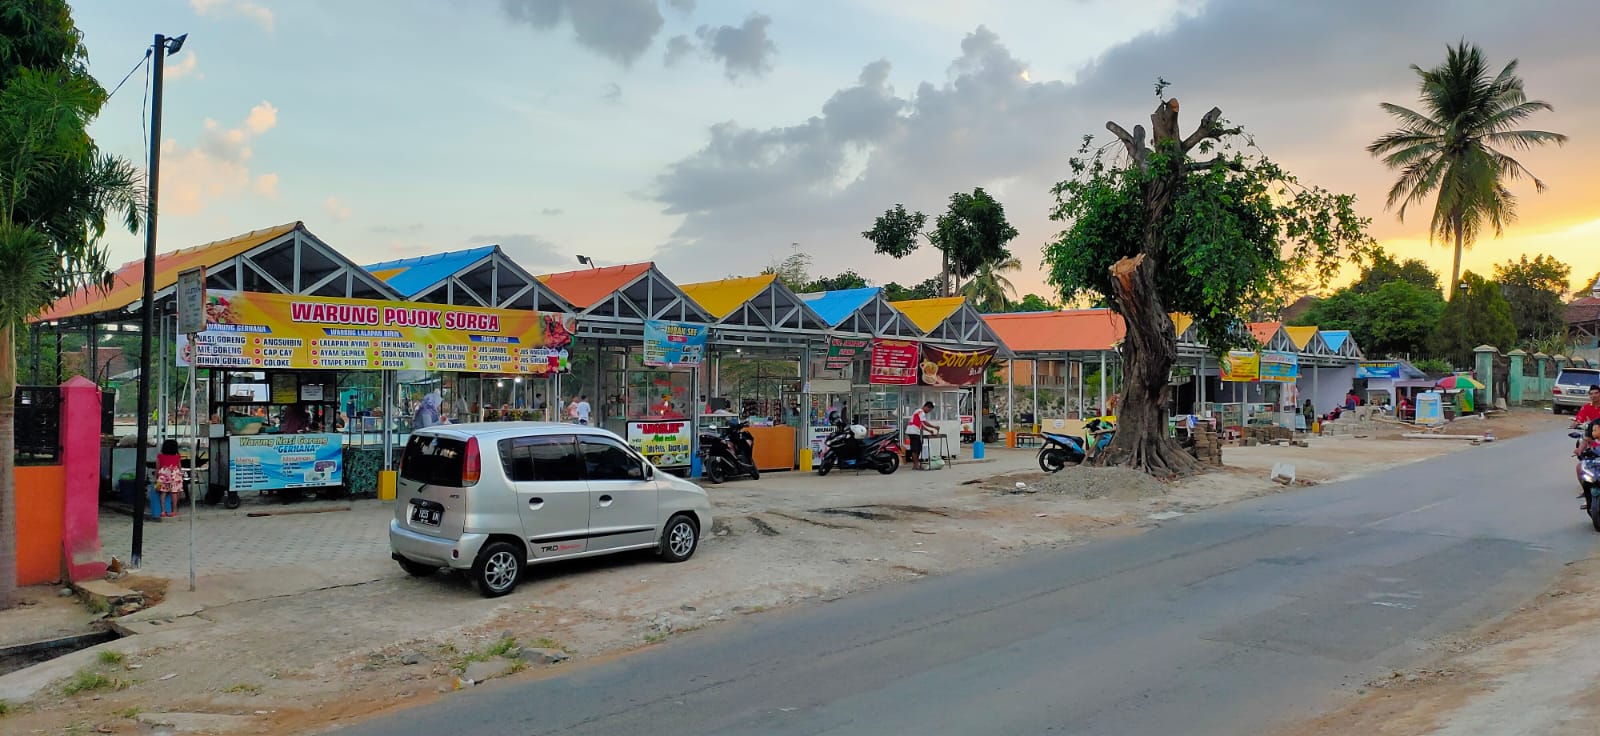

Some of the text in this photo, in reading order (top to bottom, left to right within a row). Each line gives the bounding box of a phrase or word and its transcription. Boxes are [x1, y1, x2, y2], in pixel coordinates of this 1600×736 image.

[291, 302, 500, 331] WARUNG POJOK SORGA
[216, 336, 246, 344] GORENG
[320, 340, 349, 348] LALAPAN
[197, 346, 242, 354] MIE GORENG
[264, 348, 278, 356] CAP
[436, 344, 446, 352] JUS
[381, 350, 397, 358] SODA
[197, 356, 252, 365] BIHUN GORENG
[240, 436, 328, 447] Warung Nasi Goreng
